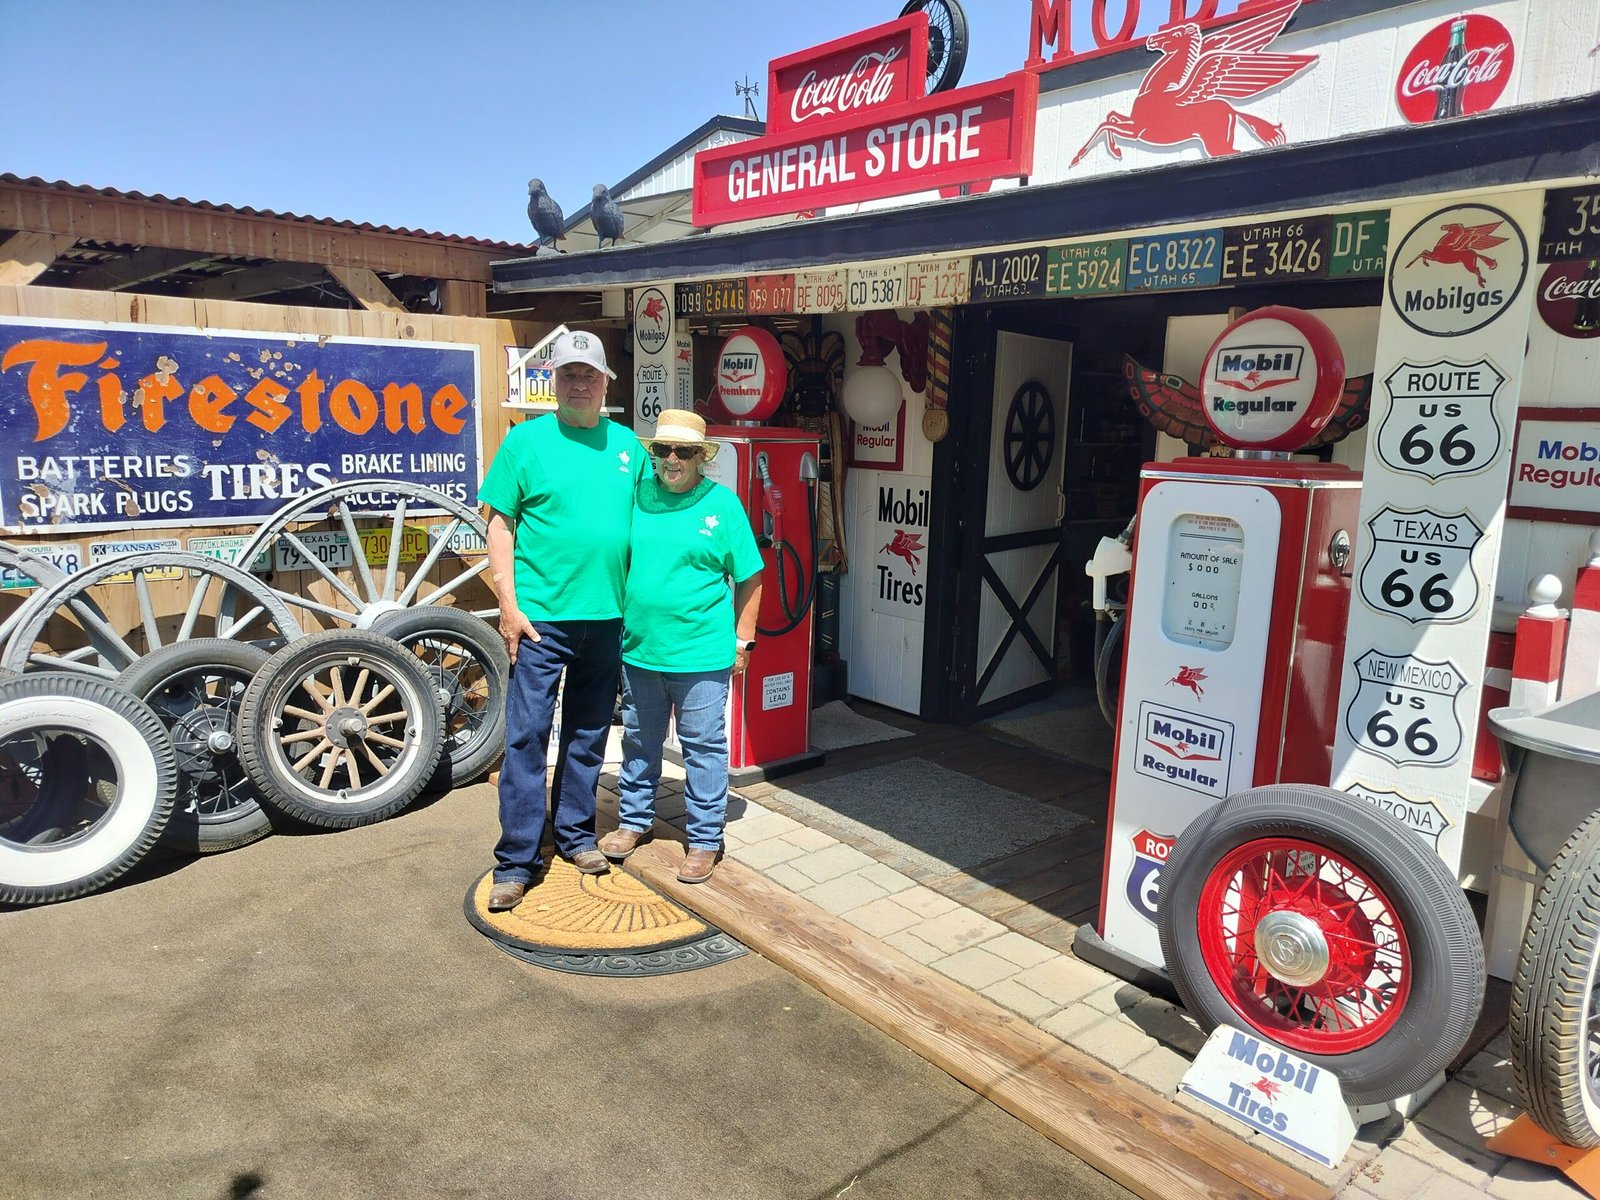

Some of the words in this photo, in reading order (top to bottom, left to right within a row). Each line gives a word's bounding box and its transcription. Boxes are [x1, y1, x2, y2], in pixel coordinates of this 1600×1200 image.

[1402, 42, 1509, 97] Coca-Cola
[790, 44, 904, 123] Coca-Cola
[727, 136, 856, 202] GENERAL
[864, 105, 983, 178] STORE
[1242, 227, 1283, 242] UTAH
[1286, 223, 1304, 238] 66
[1333, 219, 1376, 256] DF
[1061, 249, 1091, 259] UTAH
[1093, 246, 1108, 257] 64
[1129, 243, 1160, 275] EC
[1164, 236, 1214, 271] 8322
[1223, 245, 1257, 279] EE
[1264, 238, 1321, 277] 3426
[1543, 241, 1583, 256] TAH
[861, 270, 878, 280] UTAH
[920, 264, 940, 273] UTAH
[974, 259, 996, 286] AJ
[1000, 256, 1041, 285] 2002
[1046, 262, 1073, 291] EE
[1077, 257, 1121, 290] 5924
[1353, 257, 1384, 272] UTA
[717, 282, 733, 290] UTAH
[806, 276, 822, 284] UTAH
[909, 275, 928, 300] DF
[934, 272, 966, 299] 1235
[985, 284, 1012, 298] UTAH
[1144, 275, 1178, 288] UTAH
[1181, 273, 1196, 284] 65
[714, 288, 744, 310] 6446
[773, 287, 791, 309] 077
[797, 286, 812, 308] BE
[816, 284, 844, 307] 8095
[851, 282, 868, 305] CD
[872, 278, 902, 304] 5387
[1404, 286, 1503, 314] Mobilgas
[639, 329, 666, 344] Mobilgas
[723, 358, 754, 370] Mobil
[1221, 353, 1294, 372] Mobil
[642, 370, 662, 381] ROUTE
[1407, 371, 1481, 392] ROUTE
[1, 339, 469, 443] Firestone
[720, 385, 761, 396] Premium
[641, 396, 662, 418] 66
[1213, 396, 1297, 416] Regular
[857, 433, 895, 448] Regular
[1399, 423, 1476, 466] 66
[1538, 440, 1600, 461] Mob
[16, 454, 192, 480] BATTERIES
[340, 453, 404, 474] BRAKE
[409, 453, 467, 473] LINING
[202, 461, 335, 502] TIRES
[19, 491, 105, 519] SPARK
[117, 489, 194, 517] PLUGS
[878, 486, 930, 528] Mobil
[299, 535, 330, 543] TEXAS
[1393, 518, 1458, 543] TEXAS
[112, 543, 161, 553] KANSAS
[208, 540, 245, 549] OKLAHOMA
[361, 535, 388, 555] 730
[1180, 552, 1208, 561] AMOUNT
[1222, 556, 1238, 565] SALE
[877, 564, 924, 606] Tires
[1380, 568, 1454, 614] 66
[1191, 592, 1218, 601] GALLONS
[1367, 658, 1399, 680] NEW
[1400, 663, 1452, 691] MEXICO
[766, 685, 791, 695] CONTAINS
[769, 693, 787, 703] LEAD
[1152, 719, 1216, 751] Mobil
[1366, 709, 1438, 757] 66
[1142, 754, 1217, 788] Regular
[1227, 1031, 1320, 1094] Mobil
[1229, 1082, 1290, 1132] Tires
